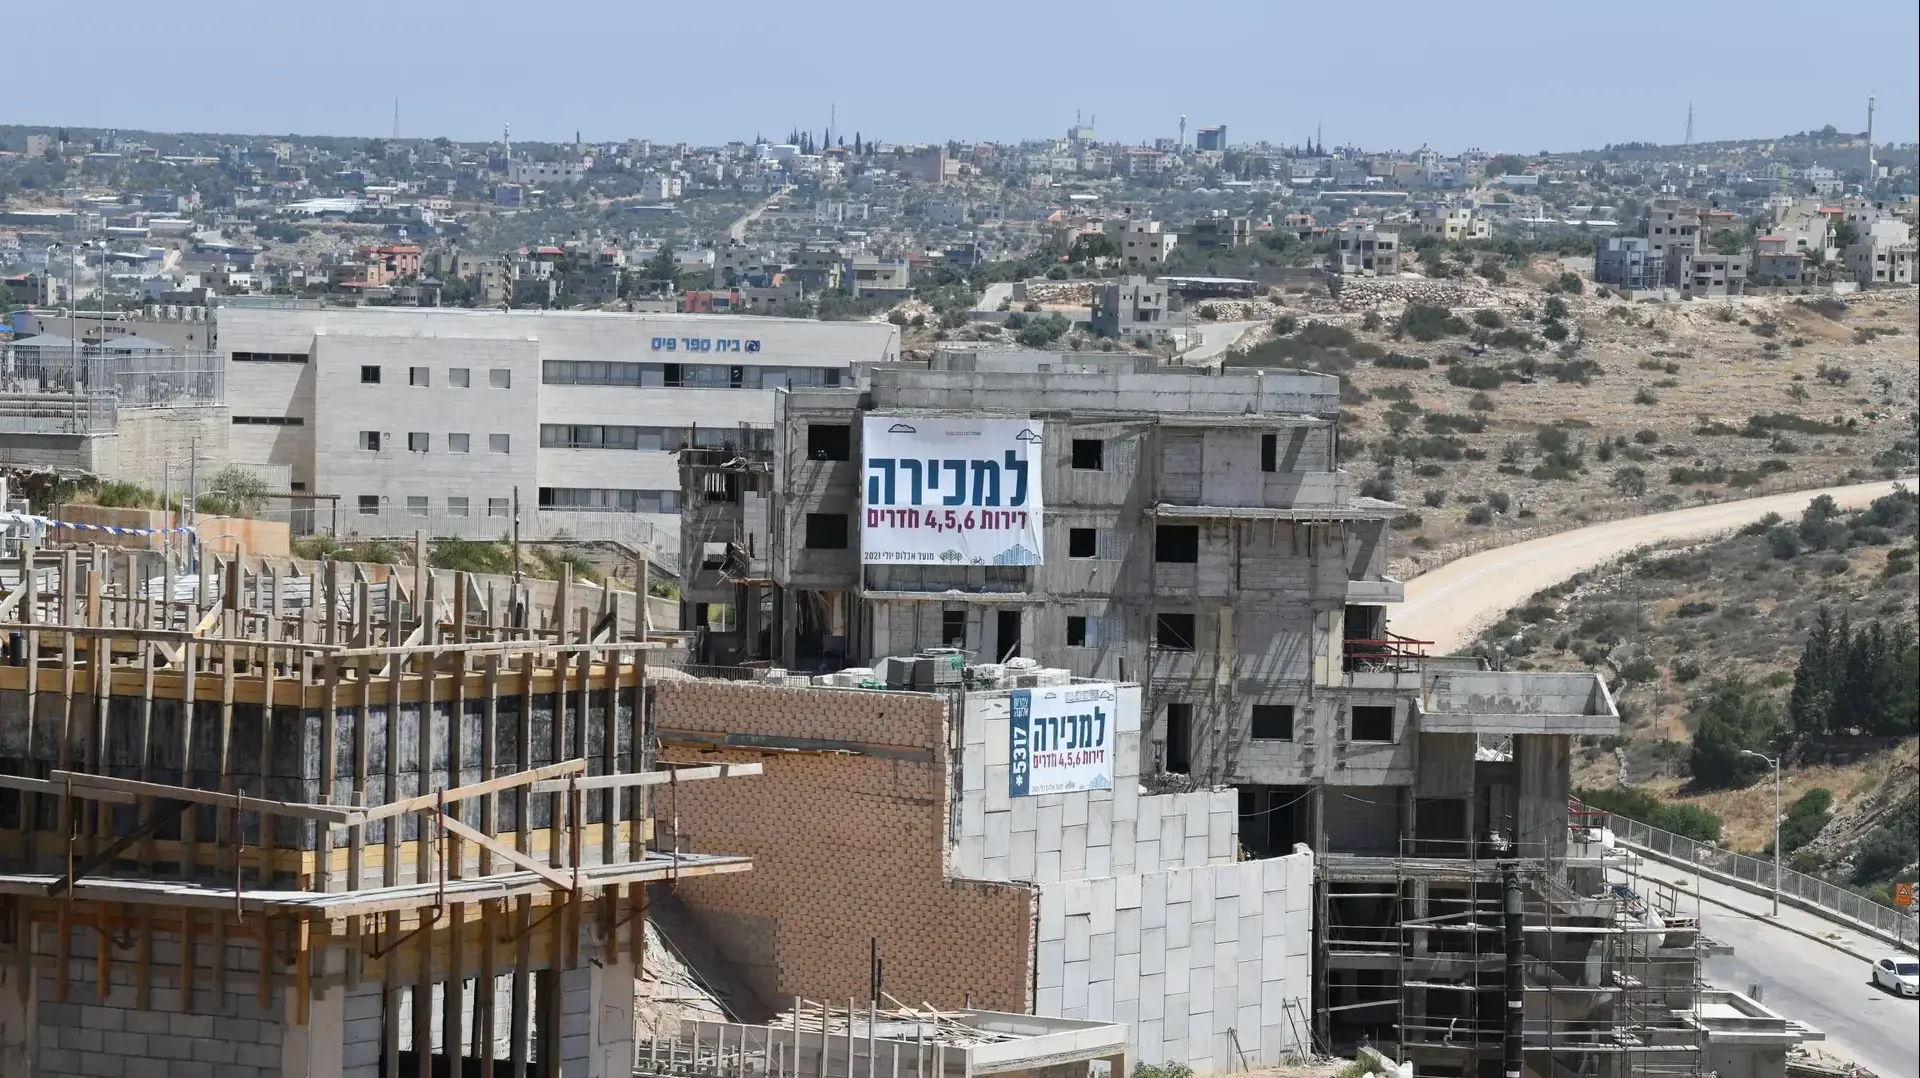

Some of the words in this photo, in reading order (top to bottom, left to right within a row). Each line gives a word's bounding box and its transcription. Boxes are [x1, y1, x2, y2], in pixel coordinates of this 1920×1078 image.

[681, 338, 711, 353] ספר
[714, 338, 741, 352] בית
[868, 450, 1029, 507] למכירה
[867, 508, 920, 529] חדרים
[924, 510, 975, 533] 4,5,6
[980, 510, 1029, 530] דירות
[864, 551, 881, 560] 2021
[882, 551, 894, 560] יולי
[895, 551, 916, 560] אכלוס
[917, 552, 934, 561] מועד
[1033, 706, 1106, 752] למכירה
[1033, 752, 1057, 769] חדרים
[1058, 751, 1081, 769] 4,5,6
[1082, 749, 1105, 765] דירות
